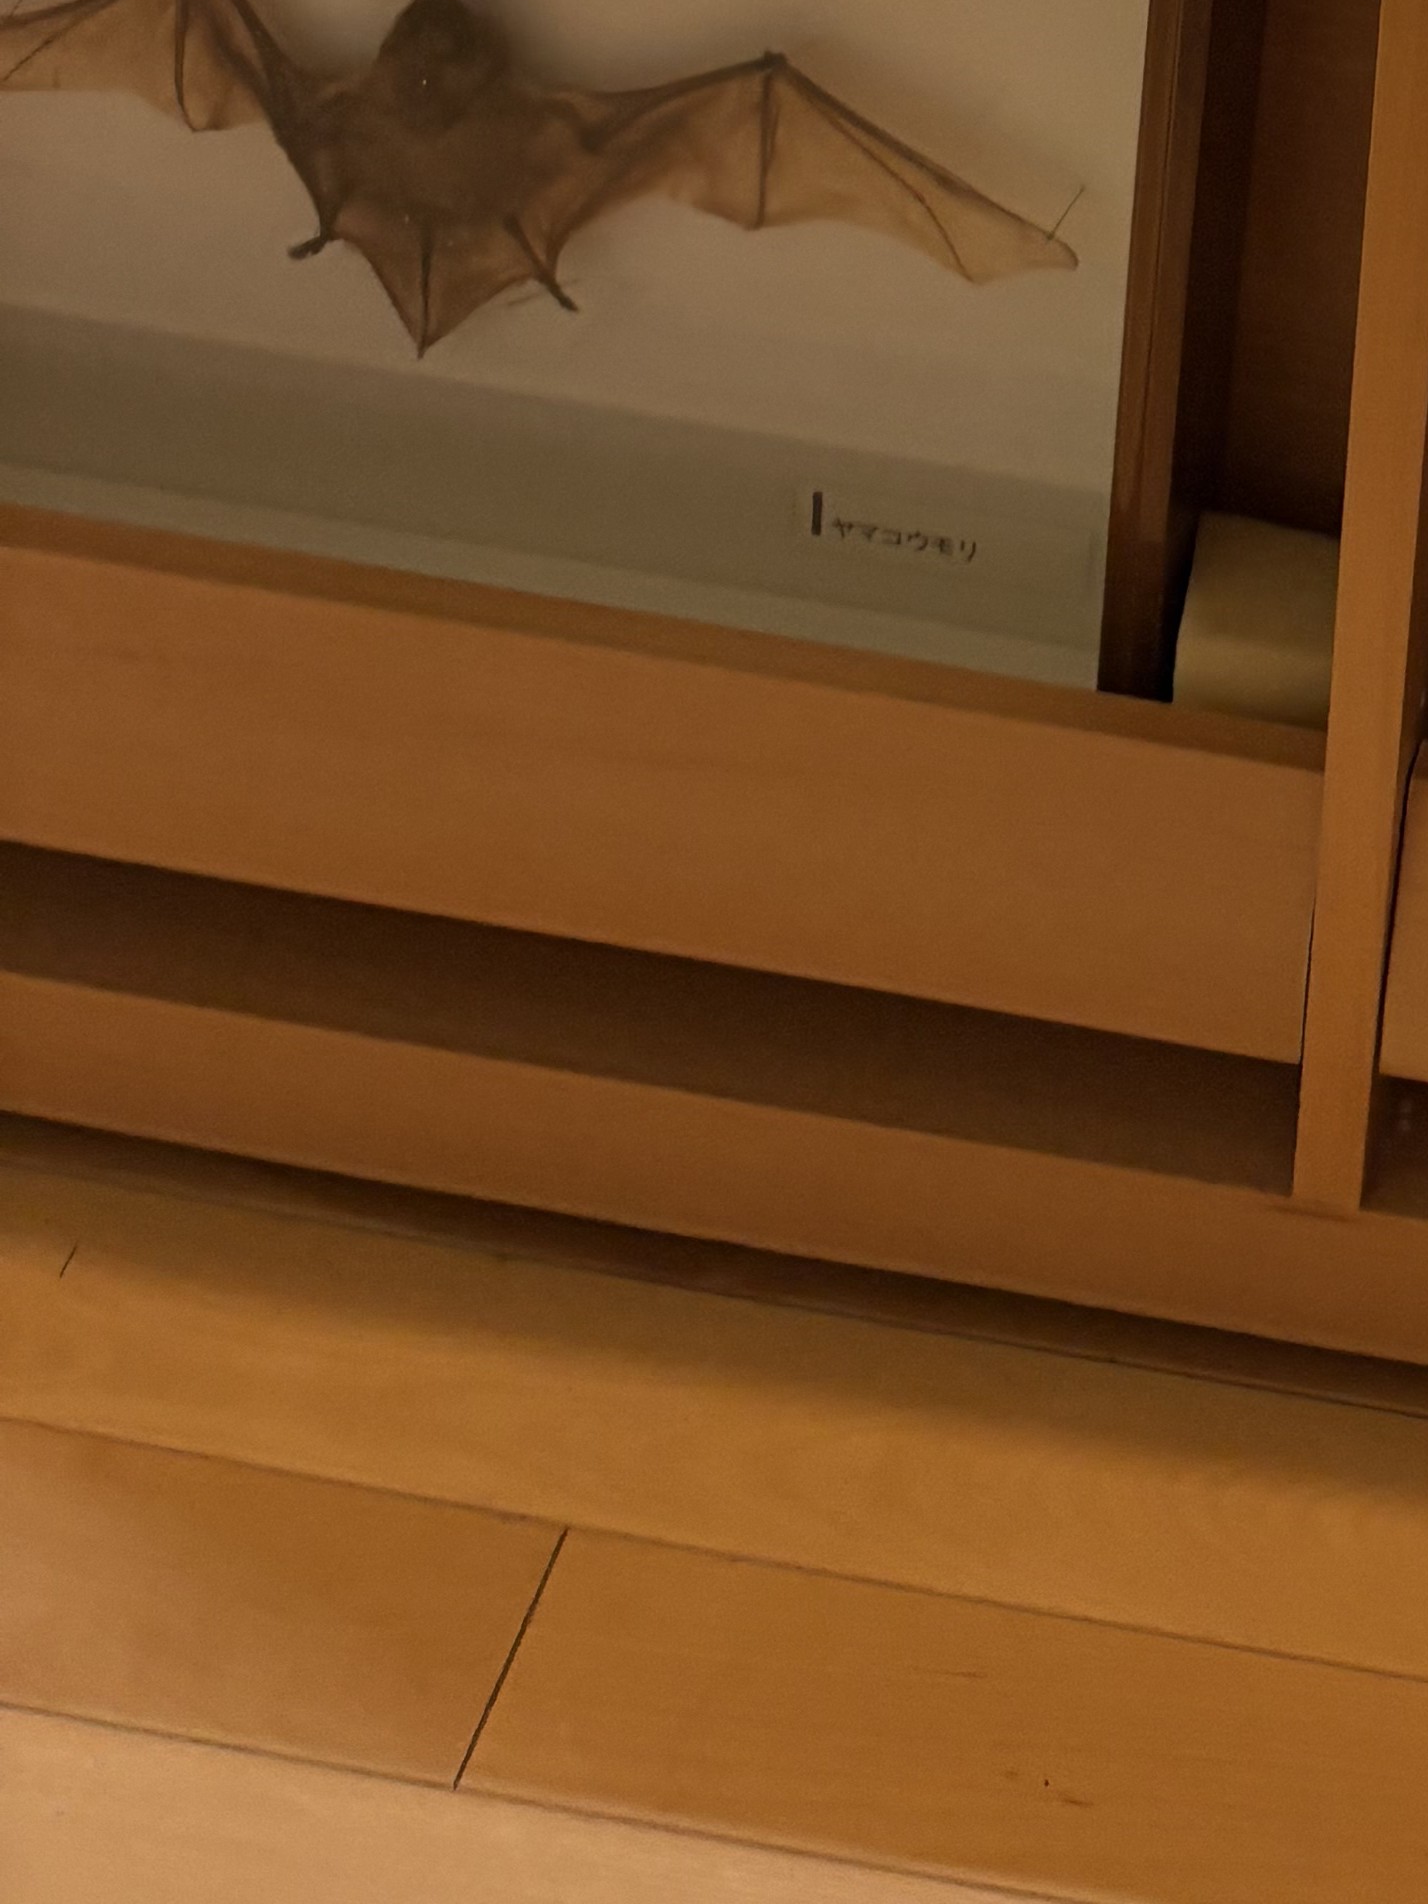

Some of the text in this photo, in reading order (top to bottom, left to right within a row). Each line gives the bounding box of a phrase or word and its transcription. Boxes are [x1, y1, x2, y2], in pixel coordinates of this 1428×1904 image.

[831, 517, 978, 564] ヤマコウモリ
